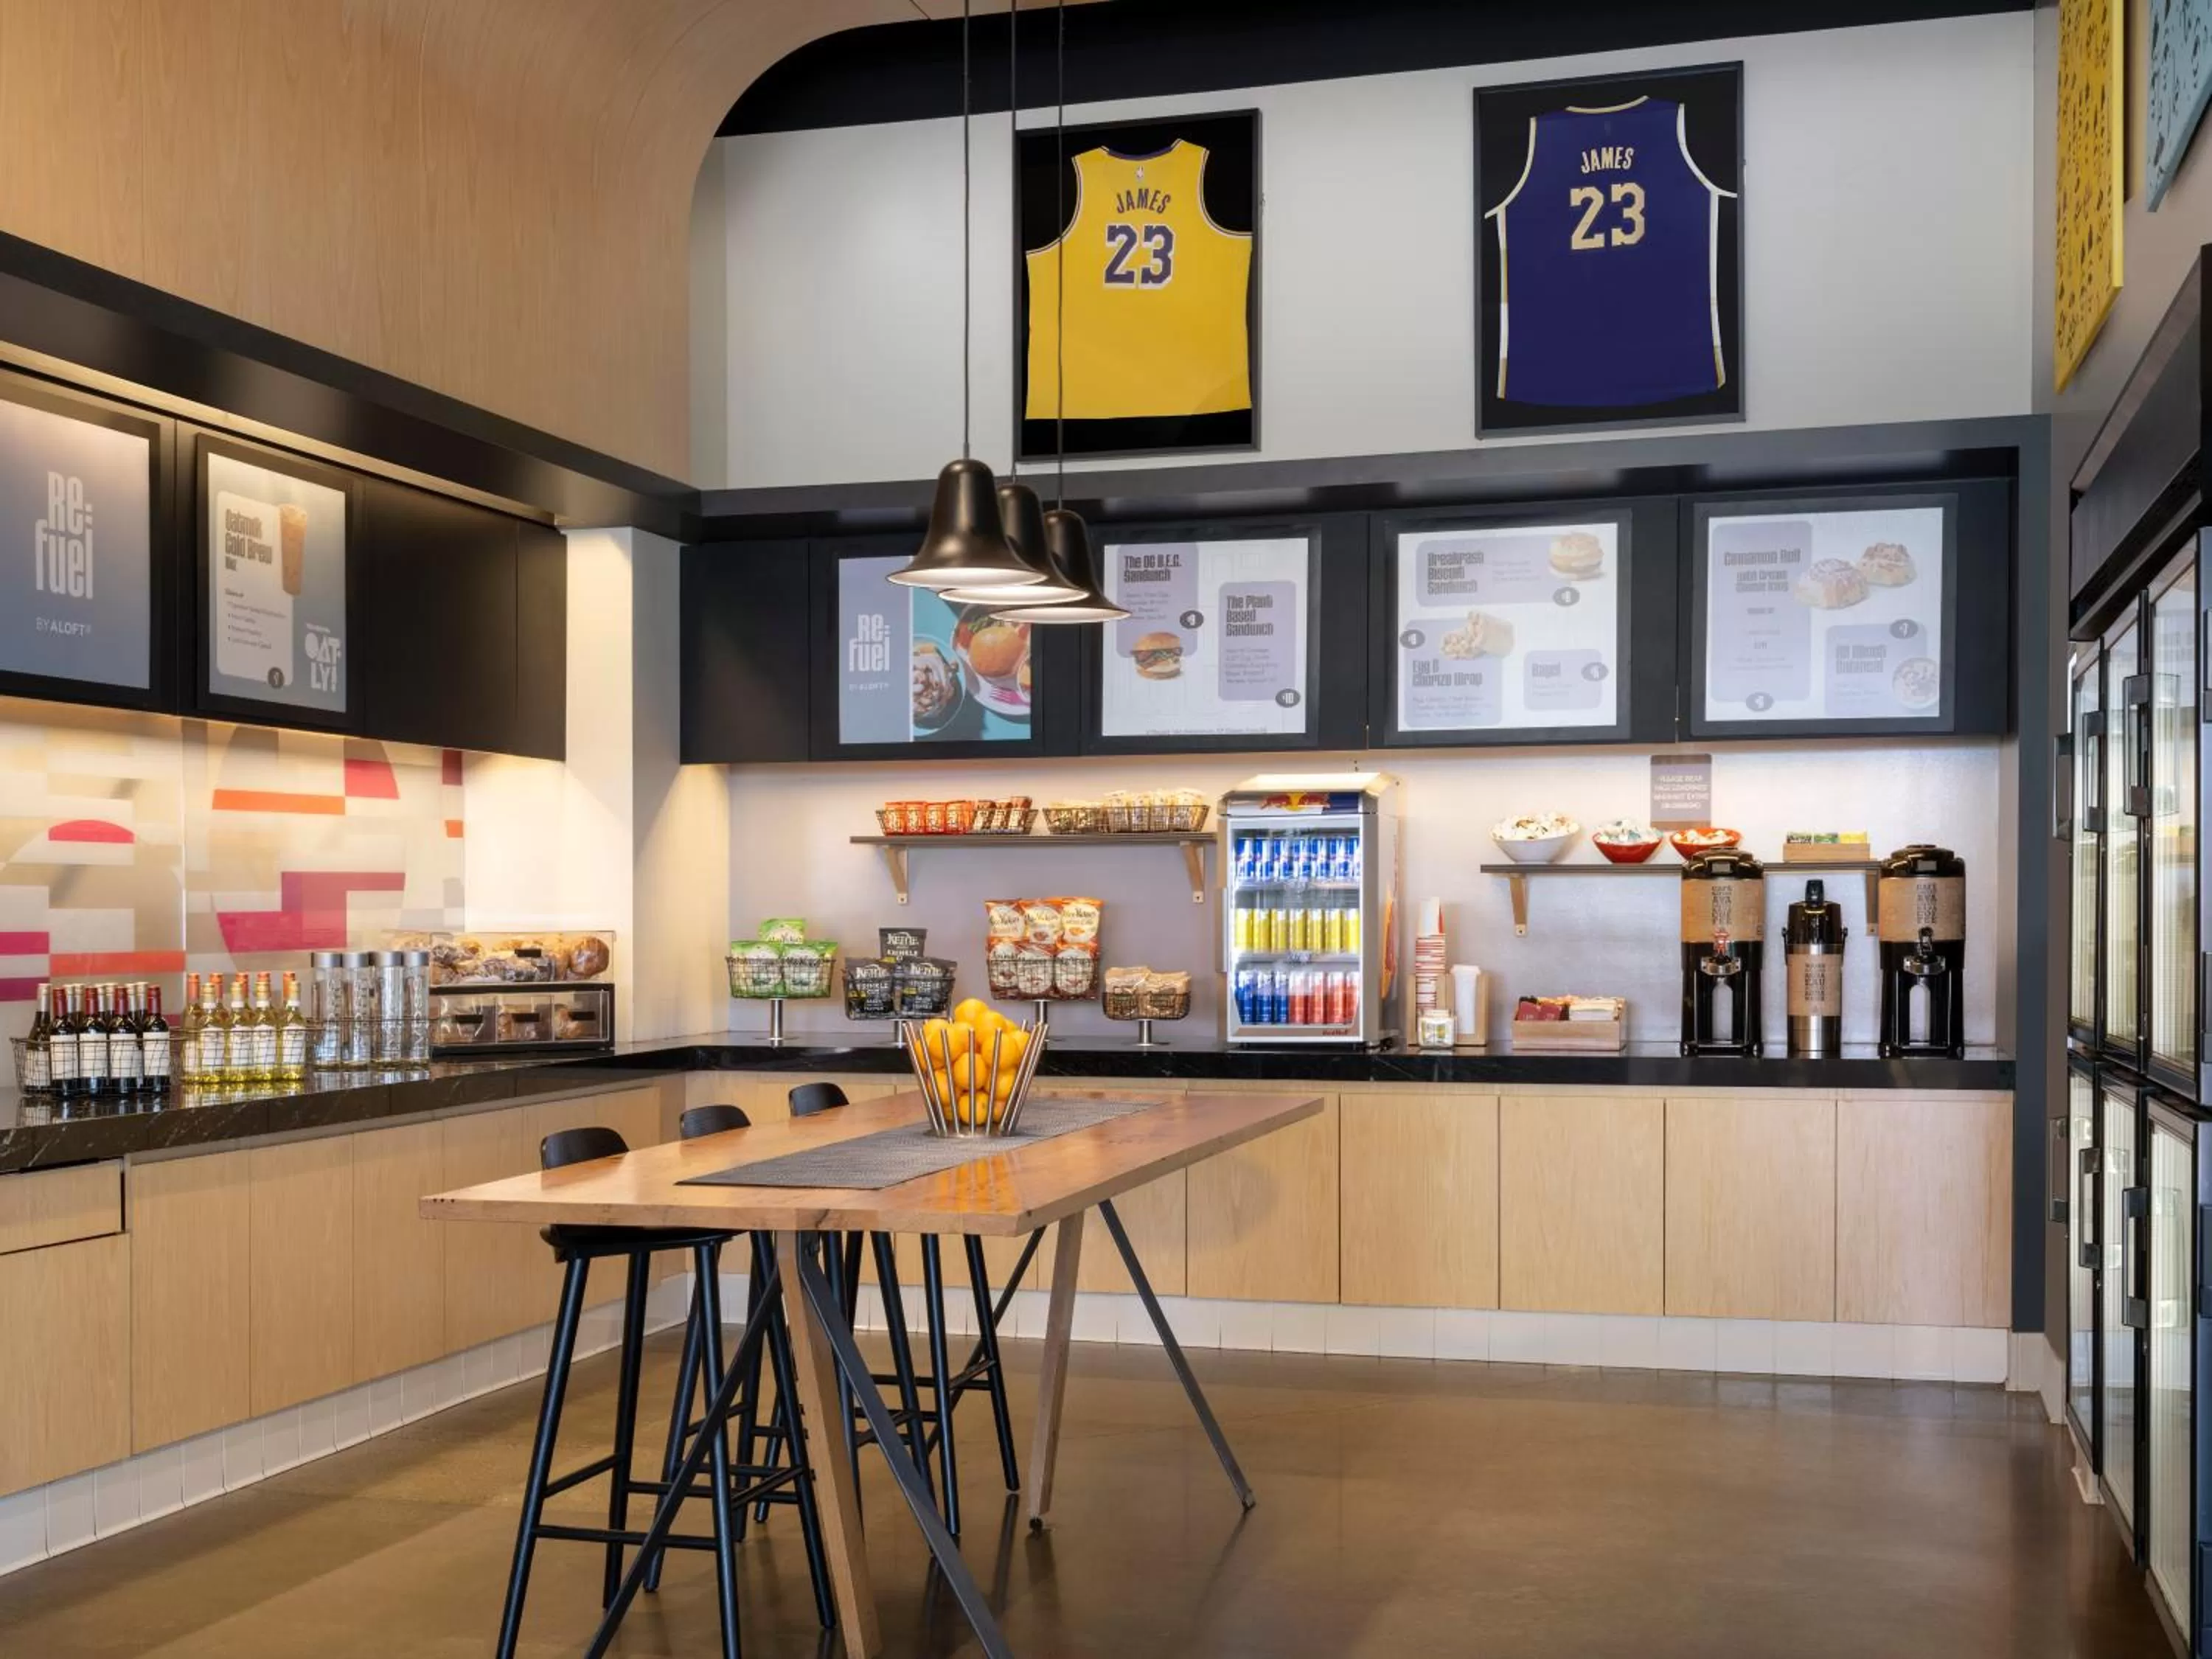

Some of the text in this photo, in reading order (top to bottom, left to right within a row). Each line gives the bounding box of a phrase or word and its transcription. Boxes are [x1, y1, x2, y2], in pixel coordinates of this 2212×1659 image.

[1581, 147, 1635, 174] JAMES
[1116, 188, 1172, 214] JAMES
[1570, 182, 1646, 250] 23
[1103, 223, 1175, 290] 23
[35, 518, 94, 599] fuel
[849, 637, 890, 672] fuel
